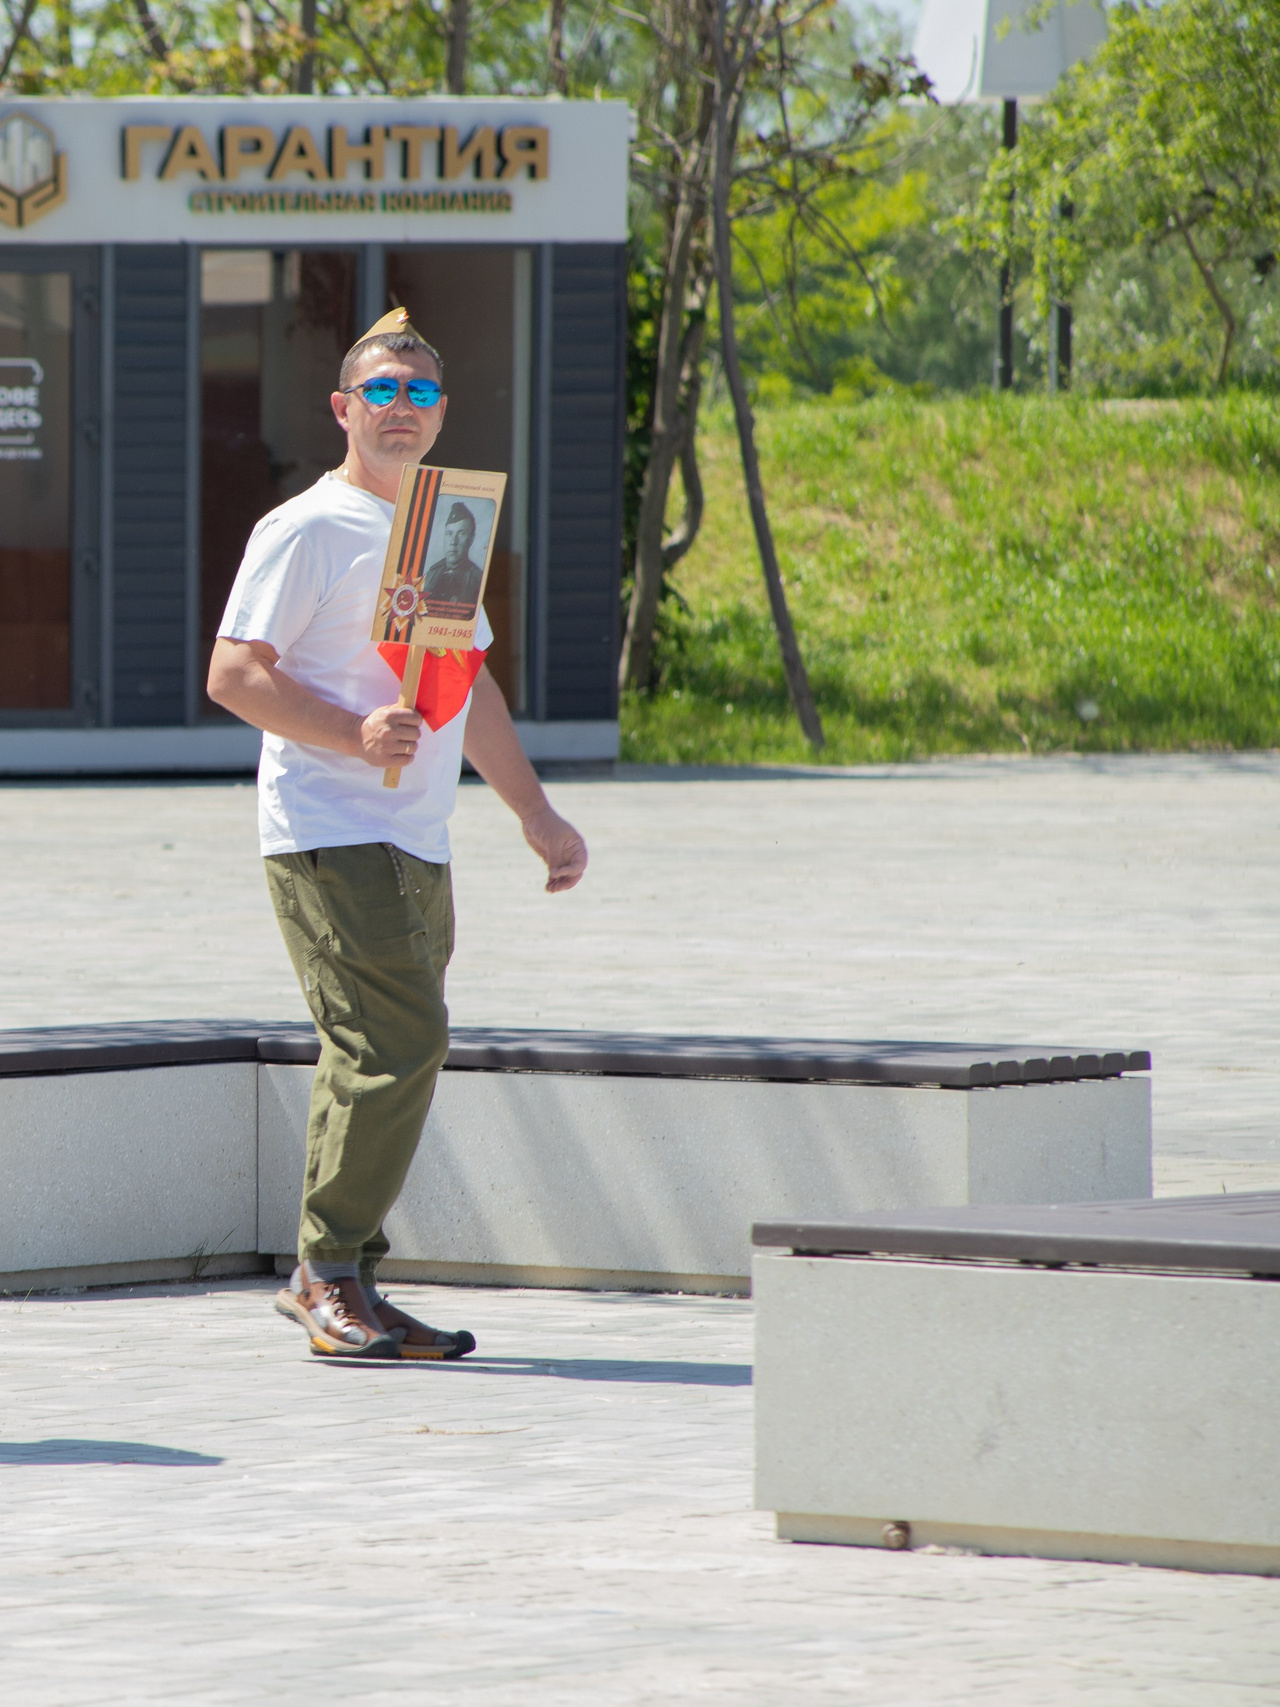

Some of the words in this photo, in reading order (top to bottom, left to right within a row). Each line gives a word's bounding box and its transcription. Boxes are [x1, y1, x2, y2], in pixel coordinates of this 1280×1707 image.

[122, 125, 549, 182] ГАРАНТИЯ
[381, 191, 513, 214] КОМПАНИЯ
[427, 625, 474, 639] 1941-1945
